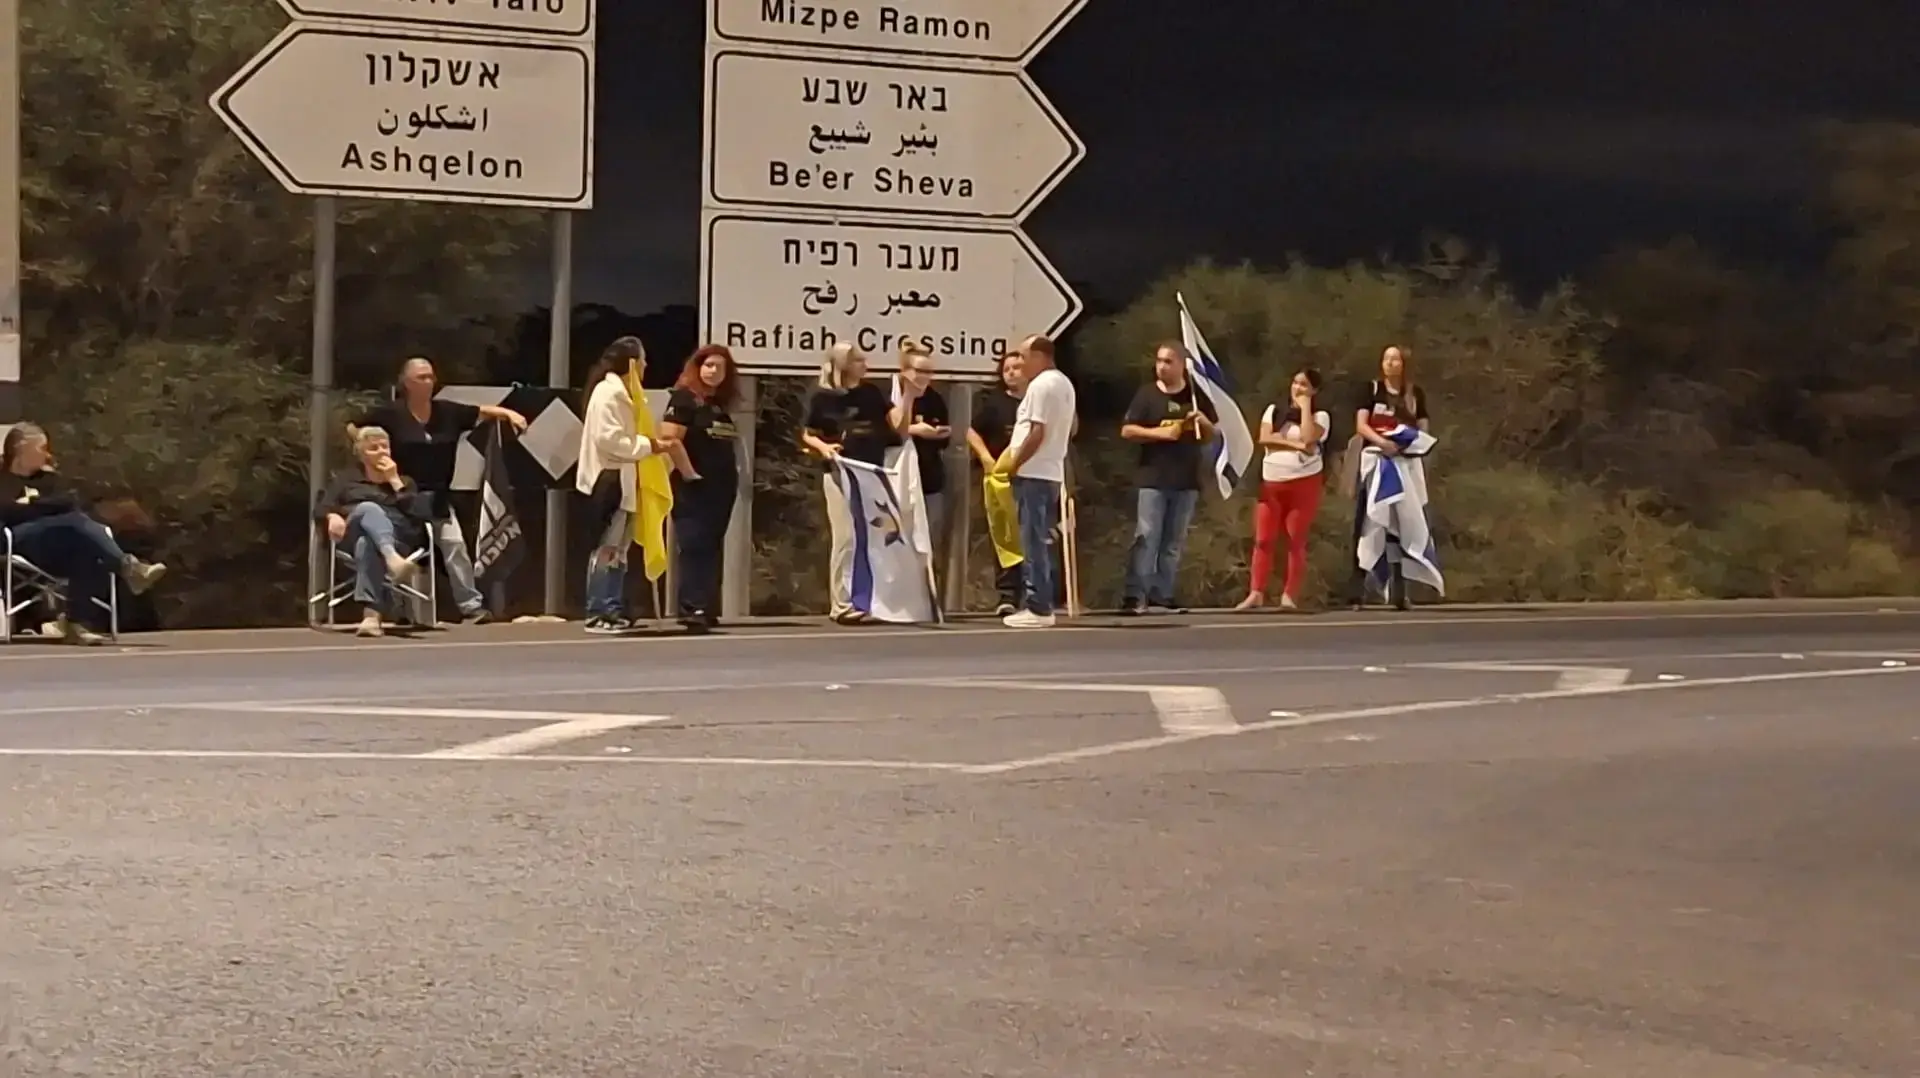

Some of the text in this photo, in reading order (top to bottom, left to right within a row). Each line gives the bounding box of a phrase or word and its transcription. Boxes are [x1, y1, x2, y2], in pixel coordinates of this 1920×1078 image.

[761, 0, 990, 41] Mizpe Ramon
[365, 51, 501, 89] אשקלון
[802, 77, 947, 112] באר שבע
[377, 103, 488, 138] اشكلون
[341, 142, 522, 181] Ashqelon
[769, 160, 973, 198] Be'er Sheva
[783, 238, 959, 272] מעבר רפיח
[803, 279, 941, 317] معبر رفح
[727, 322, 836, 351] Rafiah
